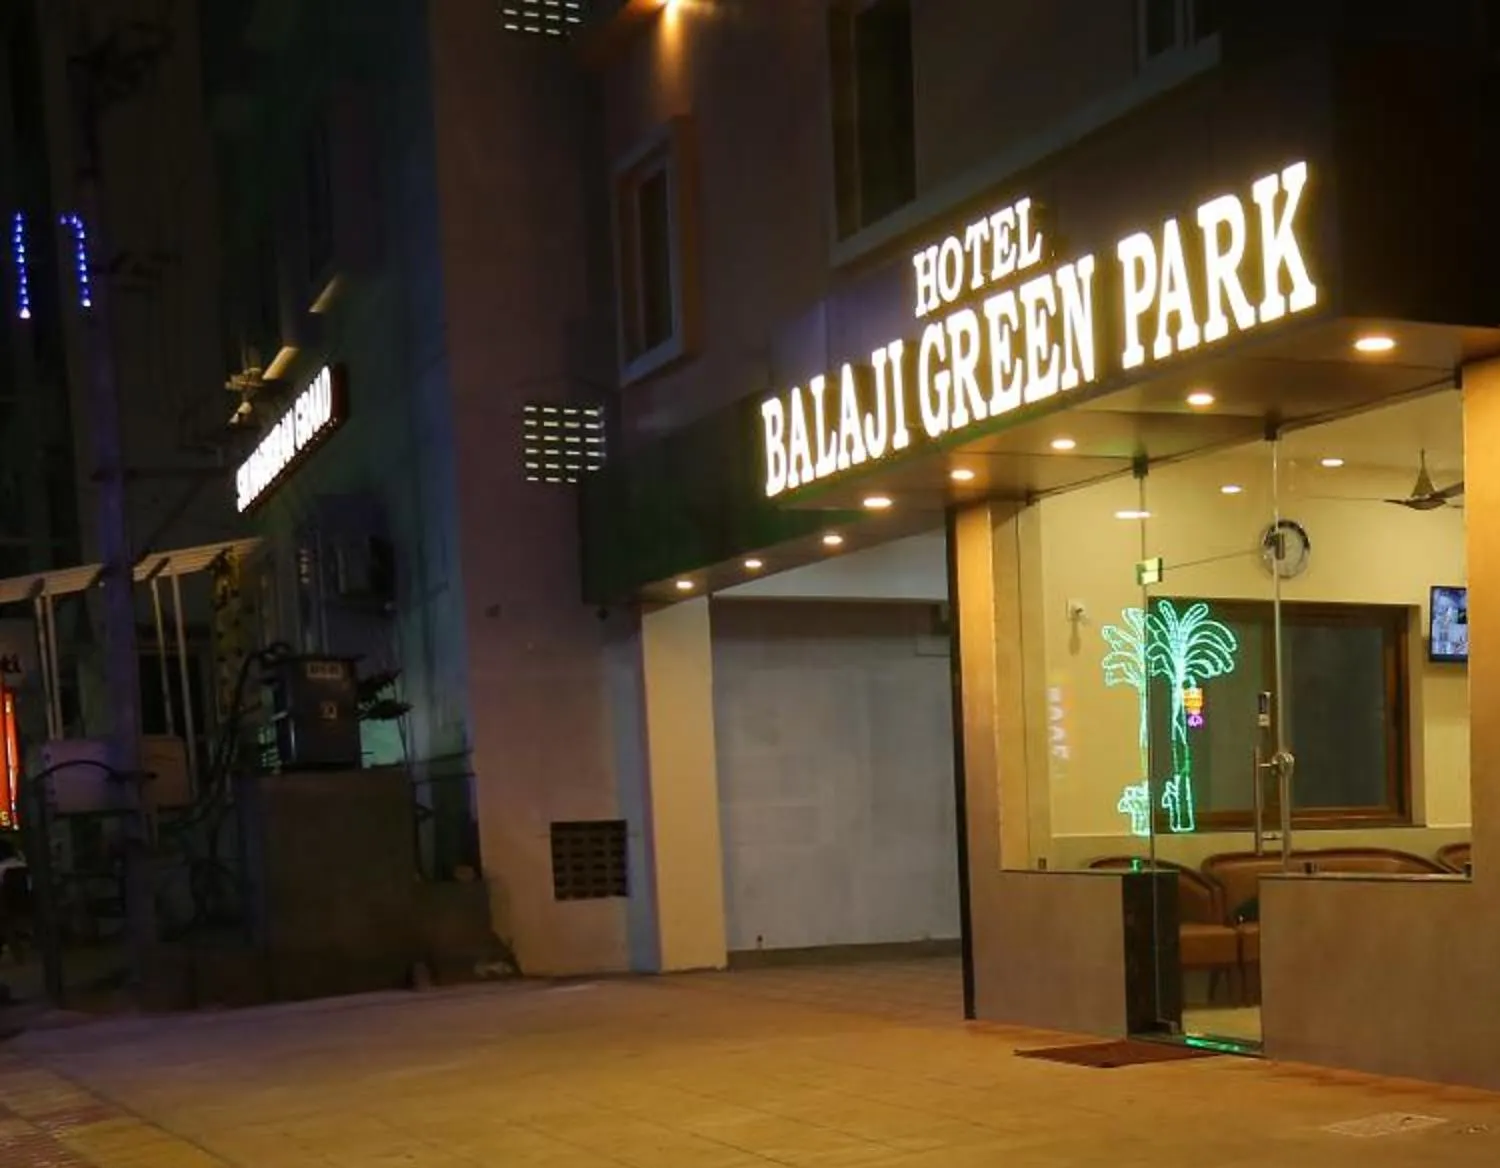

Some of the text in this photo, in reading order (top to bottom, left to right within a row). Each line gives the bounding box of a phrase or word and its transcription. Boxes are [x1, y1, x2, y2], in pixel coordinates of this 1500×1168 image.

[761, 160, 1317, 497] BALAJI GREEN PARK
[912, 197, 1042, 318] HOTEL
